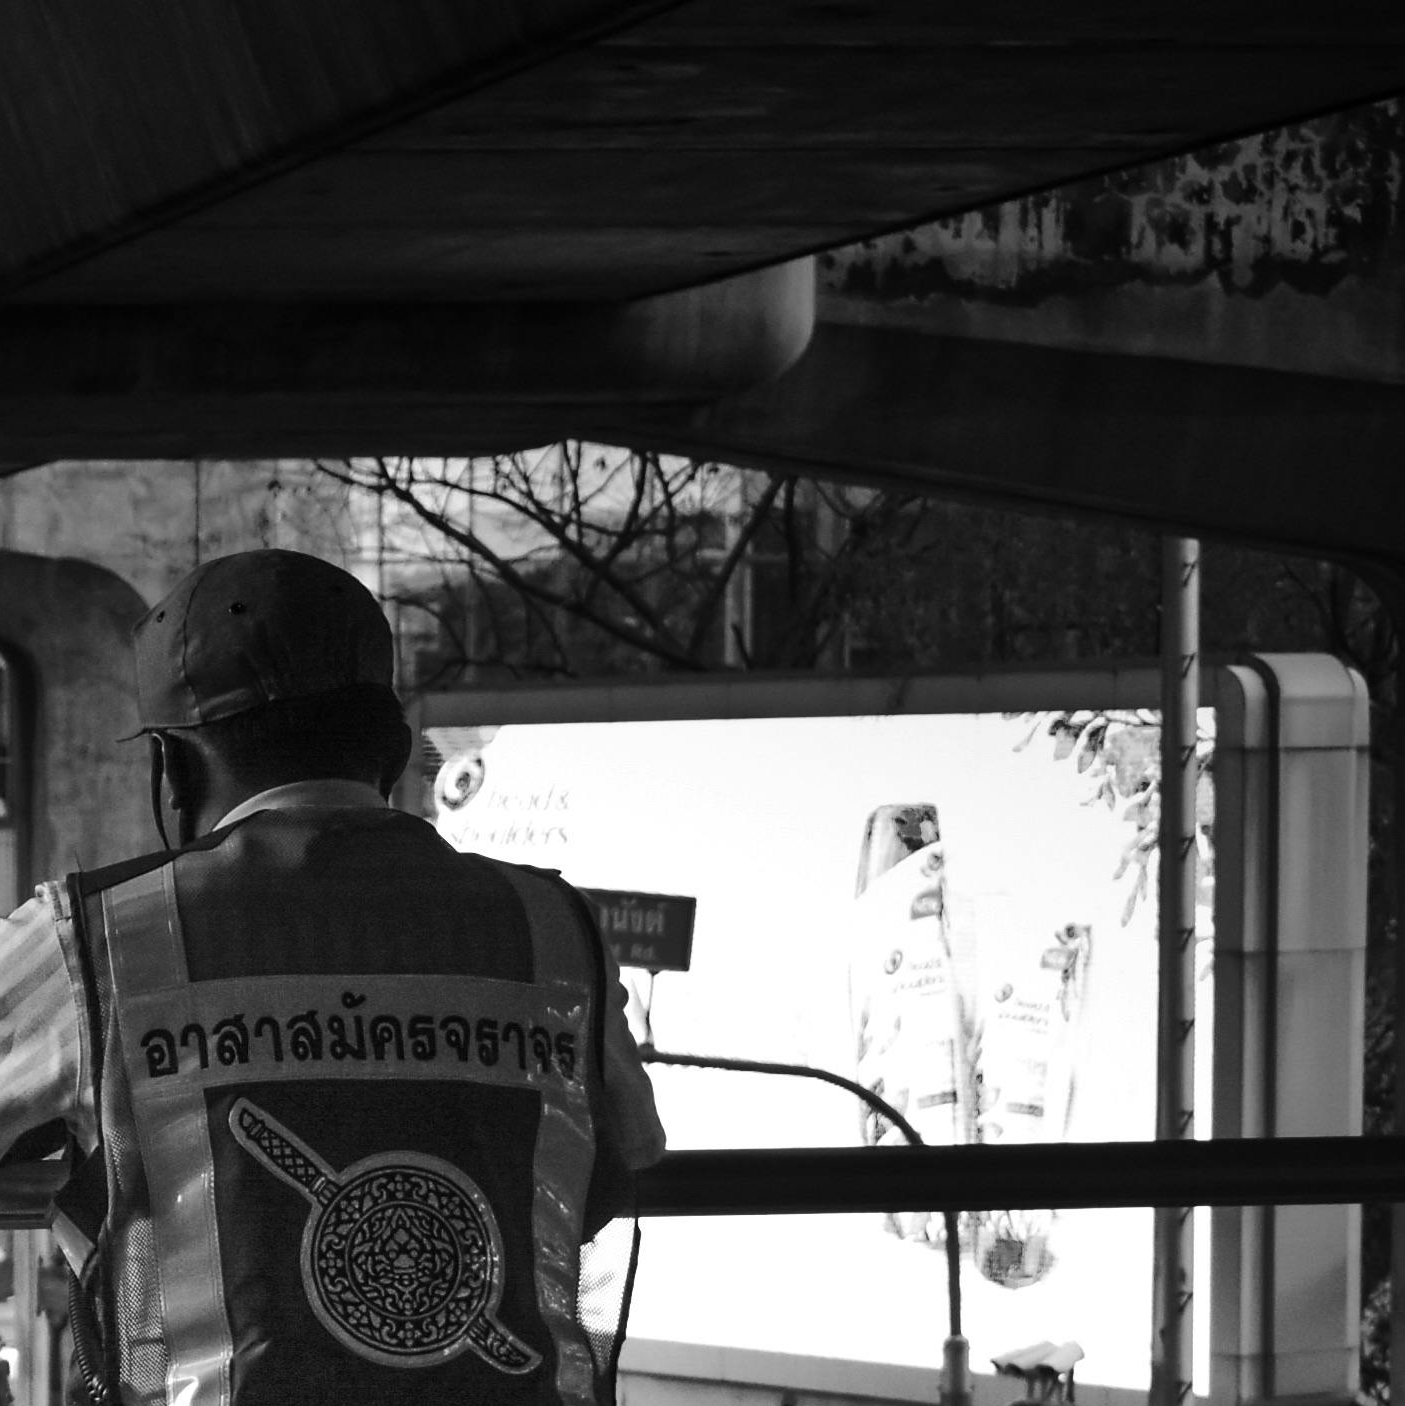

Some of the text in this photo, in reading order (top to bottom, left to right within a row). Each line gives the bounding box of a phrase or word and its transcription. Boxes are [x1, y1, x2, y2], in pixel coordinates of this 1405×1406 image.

[140, 992, 577, 1080] อาสาสมัครจราจร
